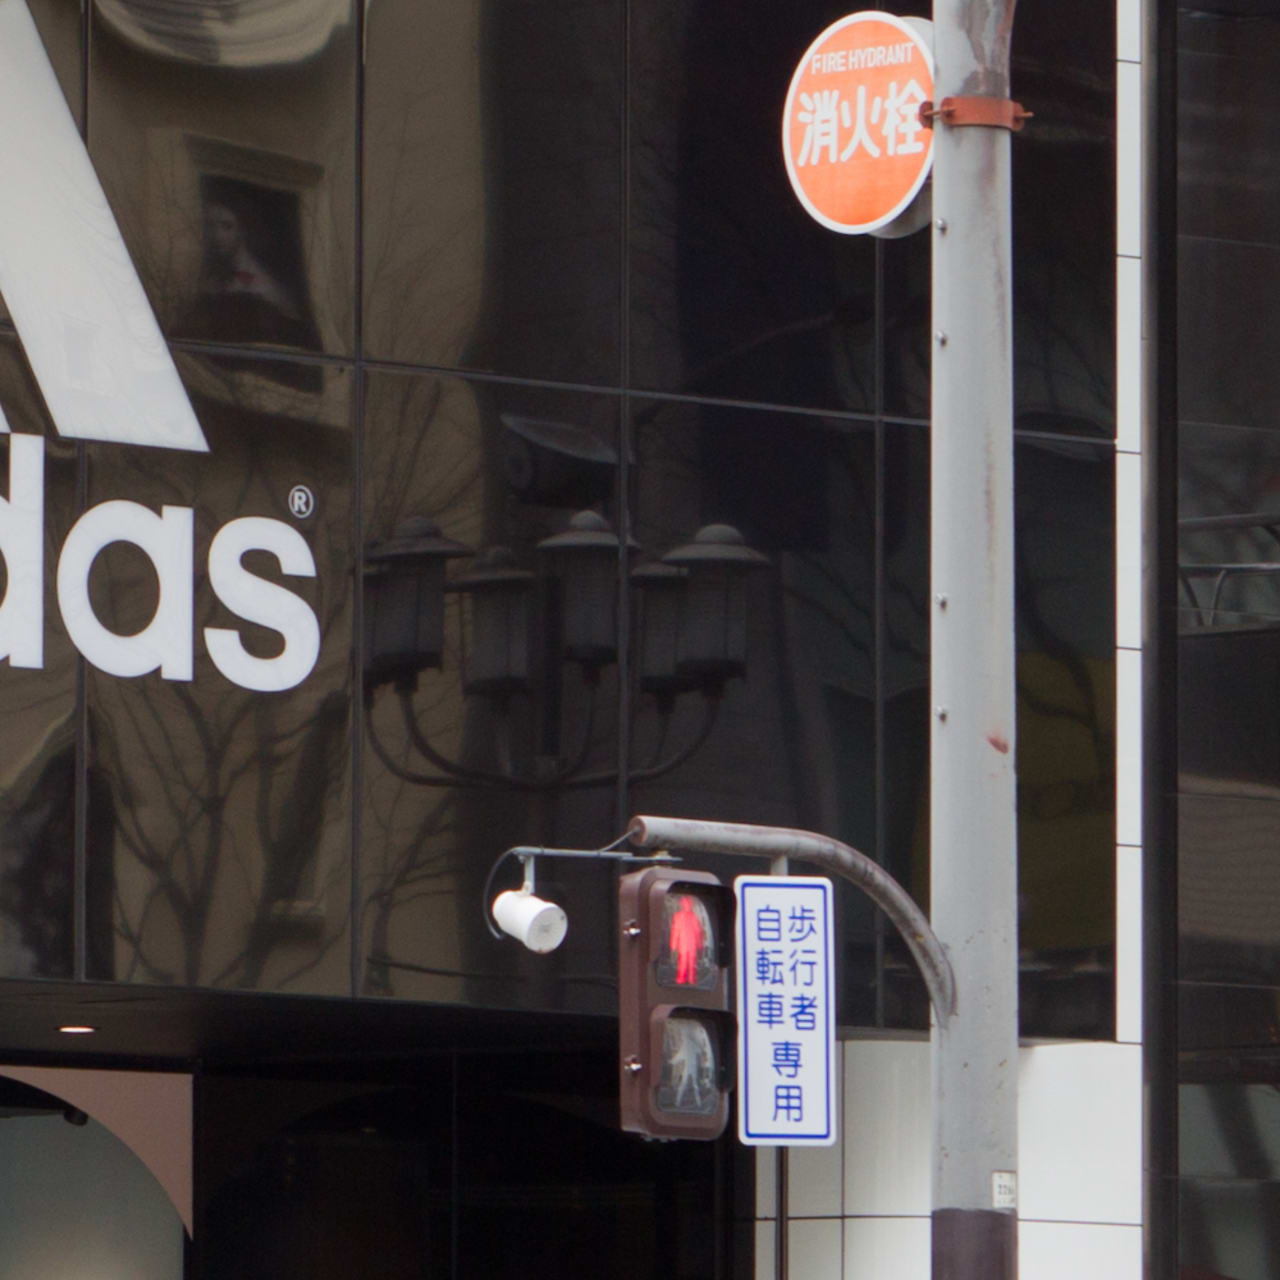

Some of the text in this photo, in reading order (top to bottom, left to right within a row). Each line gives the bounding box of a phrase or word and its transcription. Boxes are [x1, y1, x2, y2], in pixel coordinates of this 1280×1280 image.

[811, 42, 916, 75] FIRE HYDRANT
[797, 78, 929, 167] 消火栓
[755, 904, 786, 1031] 自転車
[788, 904, 818, 1032] 歩行者
[771, 1040, 804, 1124] 専用
